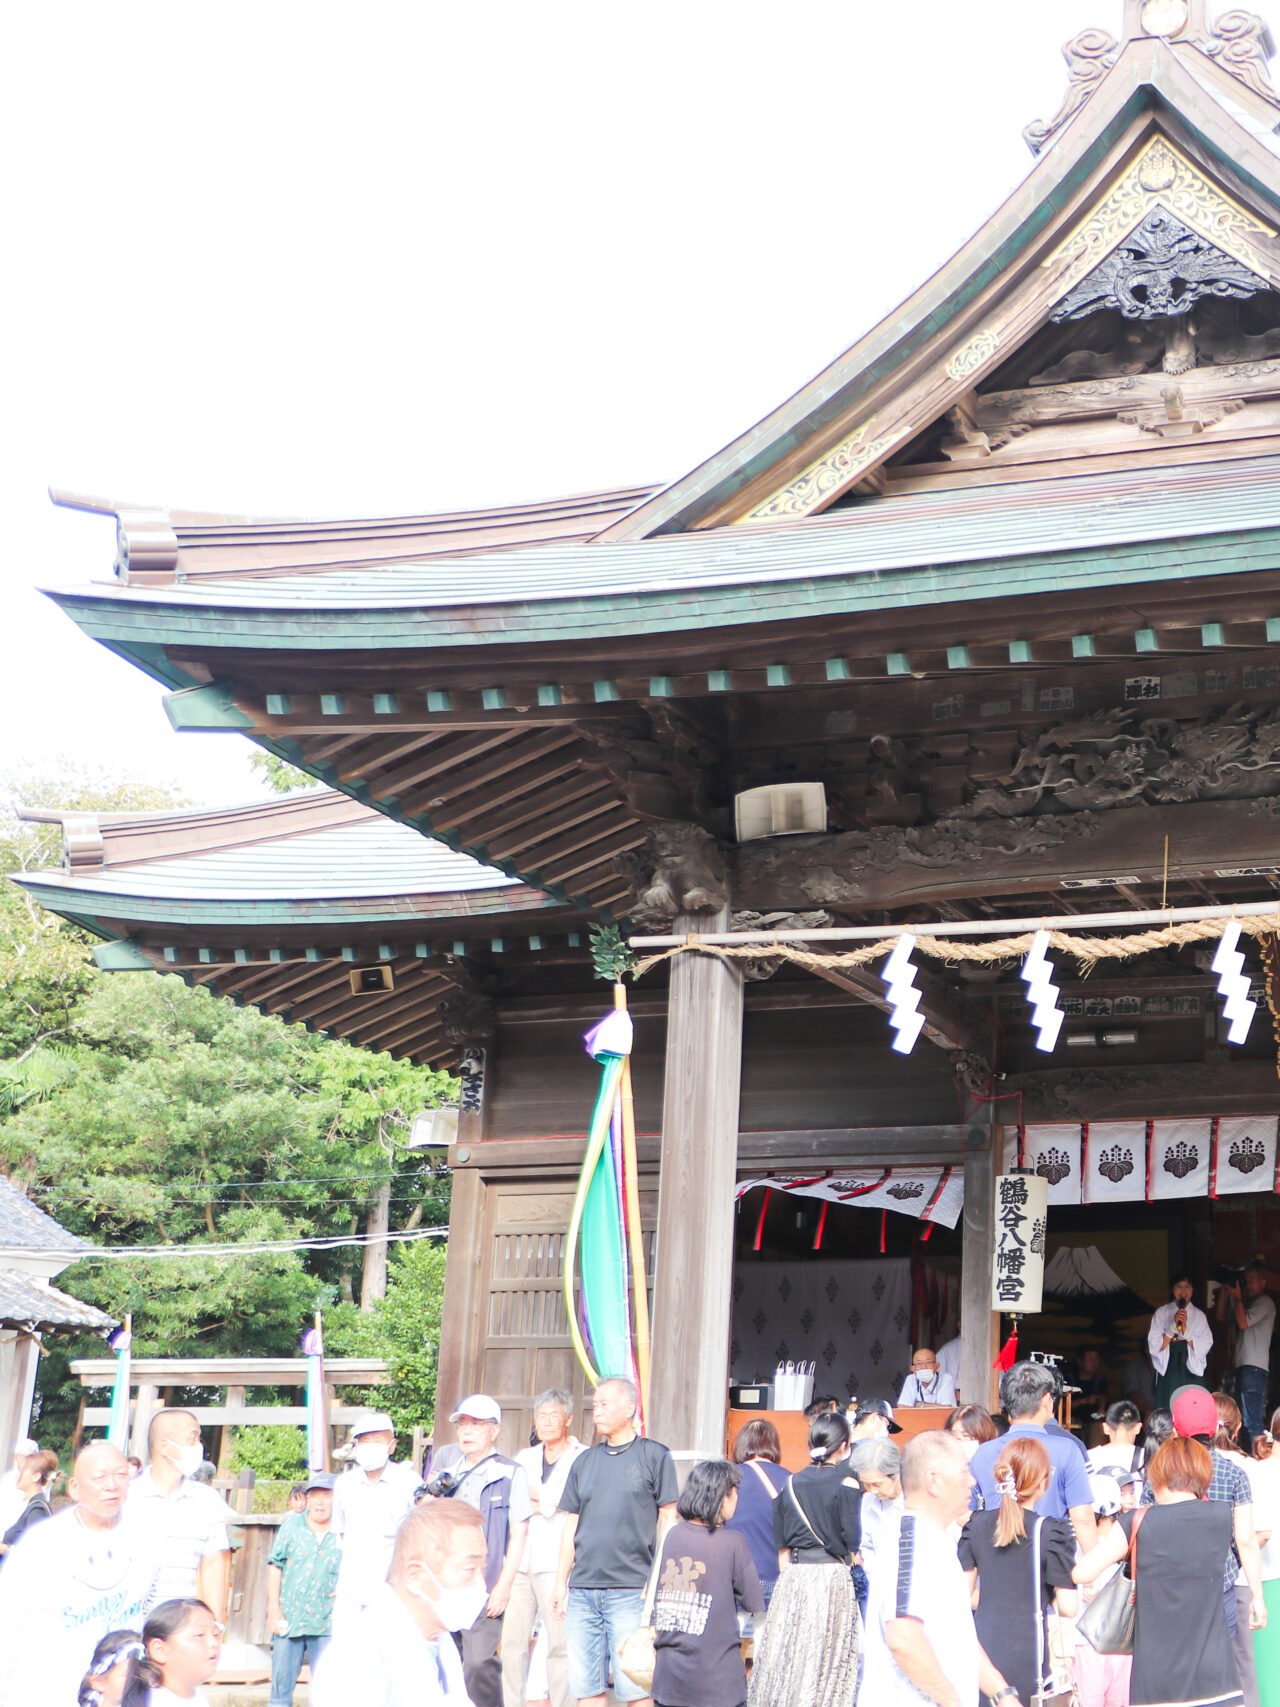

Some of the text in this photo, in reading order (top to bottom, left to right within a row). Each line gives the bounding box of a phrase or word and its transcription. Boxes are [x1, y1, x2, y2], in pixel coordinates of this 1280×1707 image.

[996, 1175, 1029, 1303] 鶴谷八幡宮
